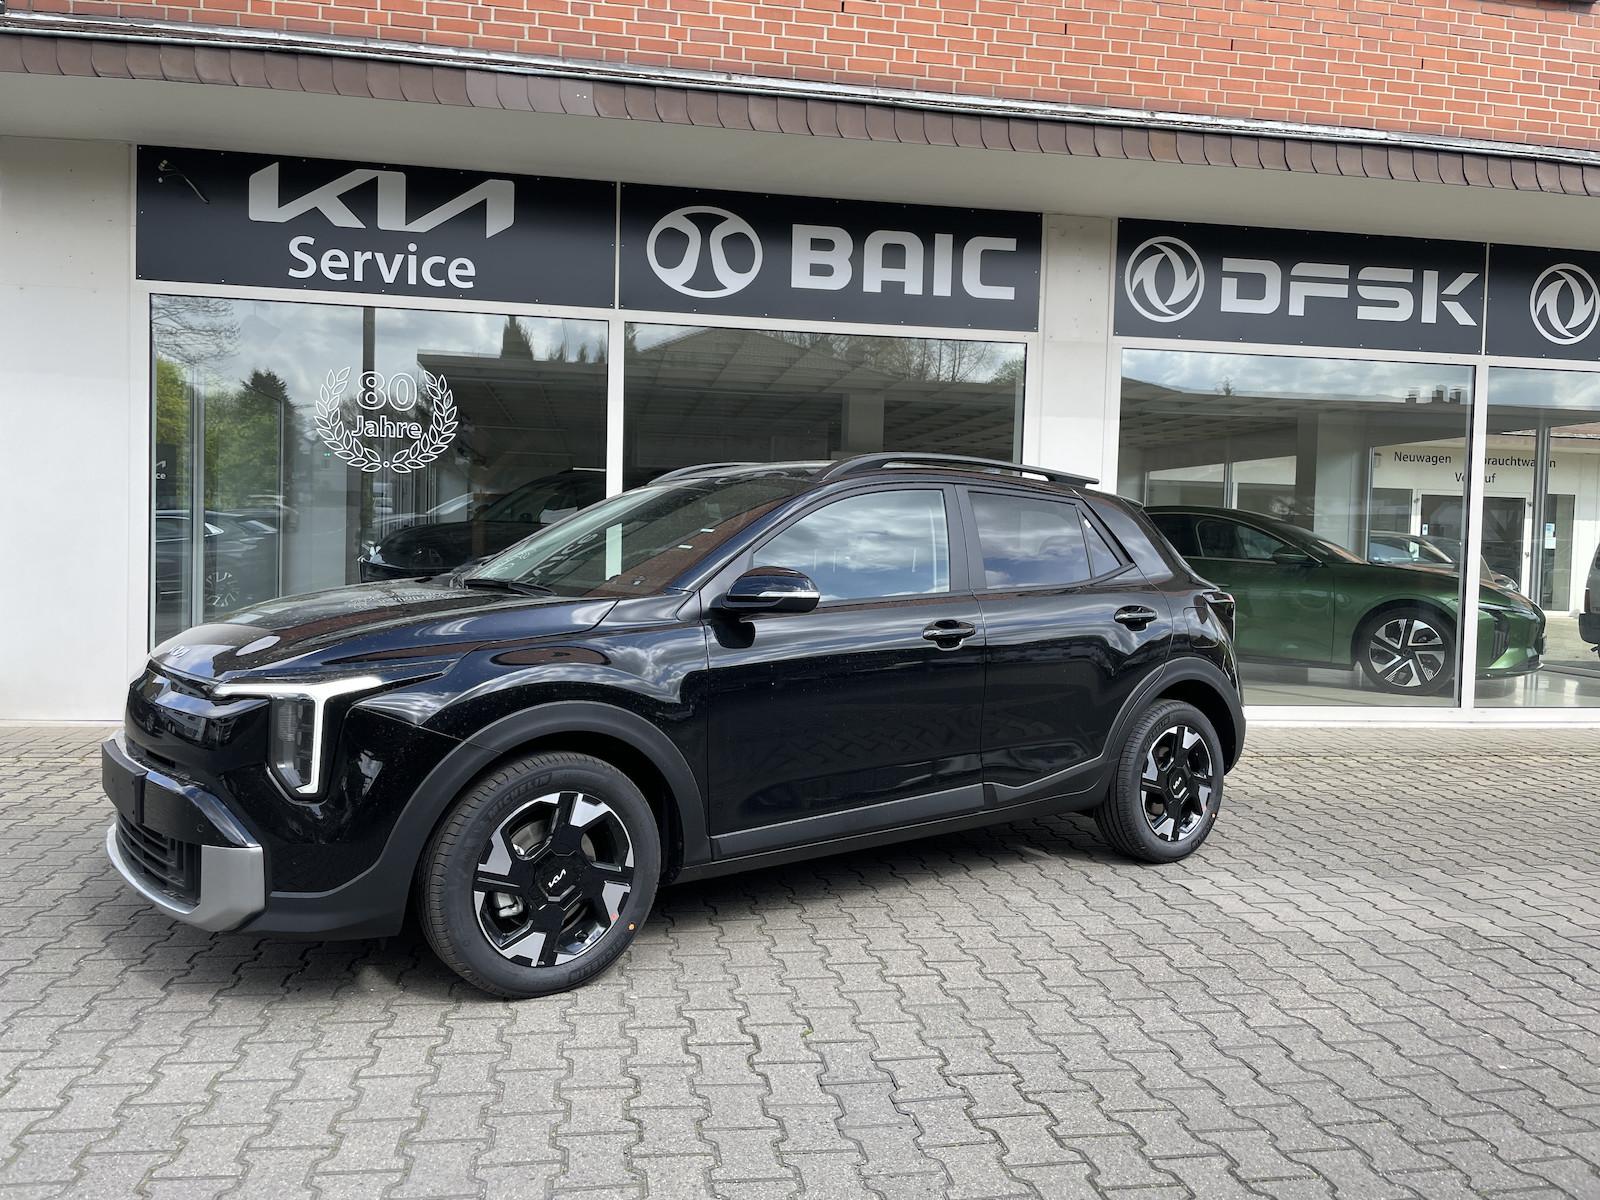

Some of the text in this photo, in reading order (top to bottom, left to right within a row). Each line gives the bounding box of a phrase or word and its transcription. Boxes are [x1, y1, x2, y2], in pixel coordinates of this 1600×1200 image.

[248, 161, 515, 238] KIA
[288, 235, 476, 289] Service
[790, 223, 1017, 301] BAIC
[1219, 257, 1479, 327] DFSK
[357, 371, 417, 411] 80
[351, 415, 422, 439] Jahre
[1394, 451, 1452, 466] Neuwagen
